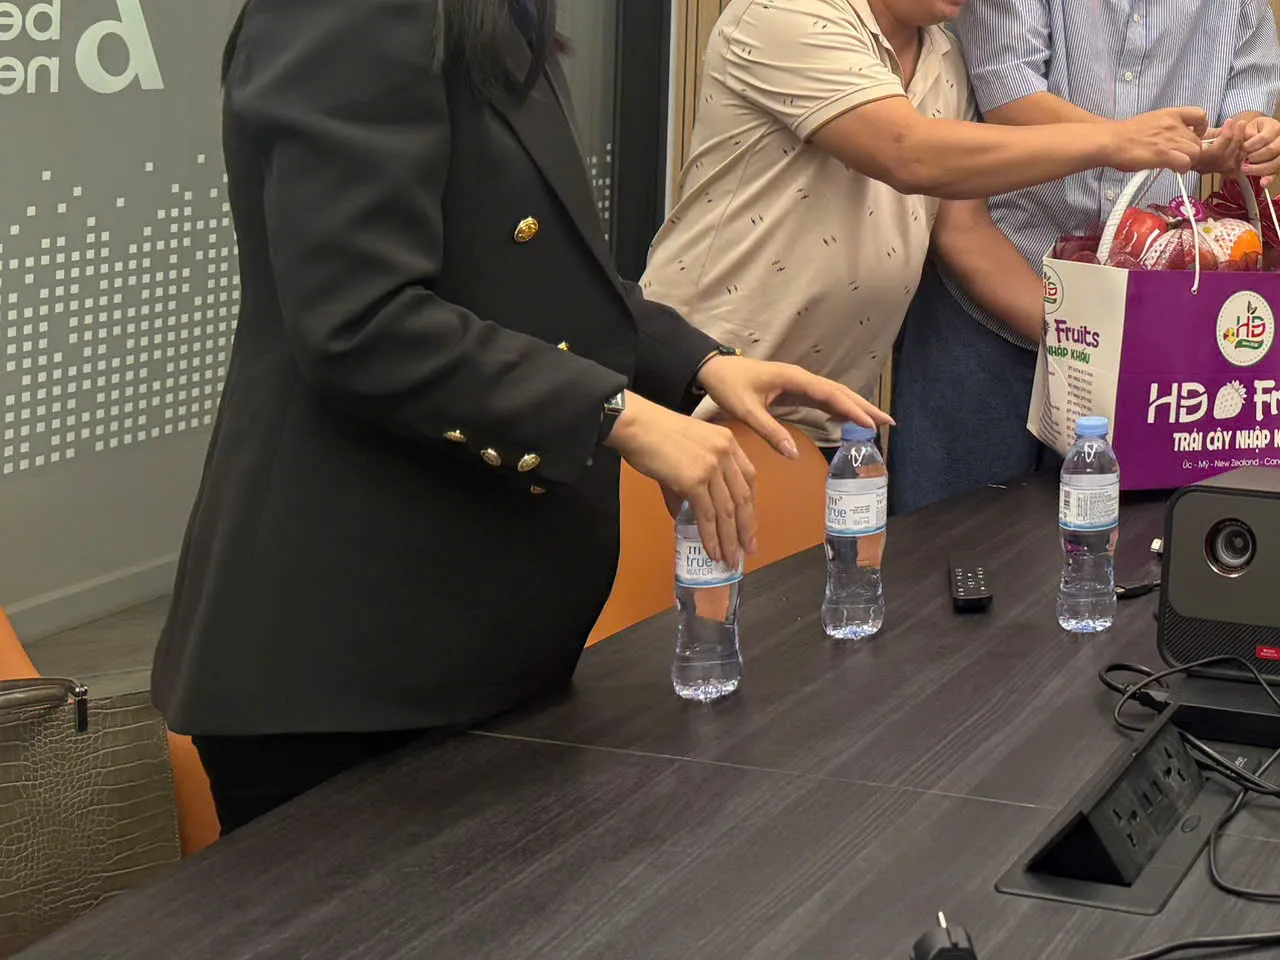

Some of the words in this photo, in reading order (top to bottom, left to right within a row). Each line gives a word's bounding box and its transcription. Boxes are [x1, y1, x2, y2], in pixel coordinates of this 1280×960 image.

[1053, 318, 1100, 349] Fruits
[1173, 427, 1204, 452] TRÁI
[1206, 426, 1233, 451] CÂY
[1235, 425, 1271, 453] NHẬP
[1214, 459, 1231, 468] New
[1231, 458, 1259, 467] Zealand
[686, 555, 713, 568] true
